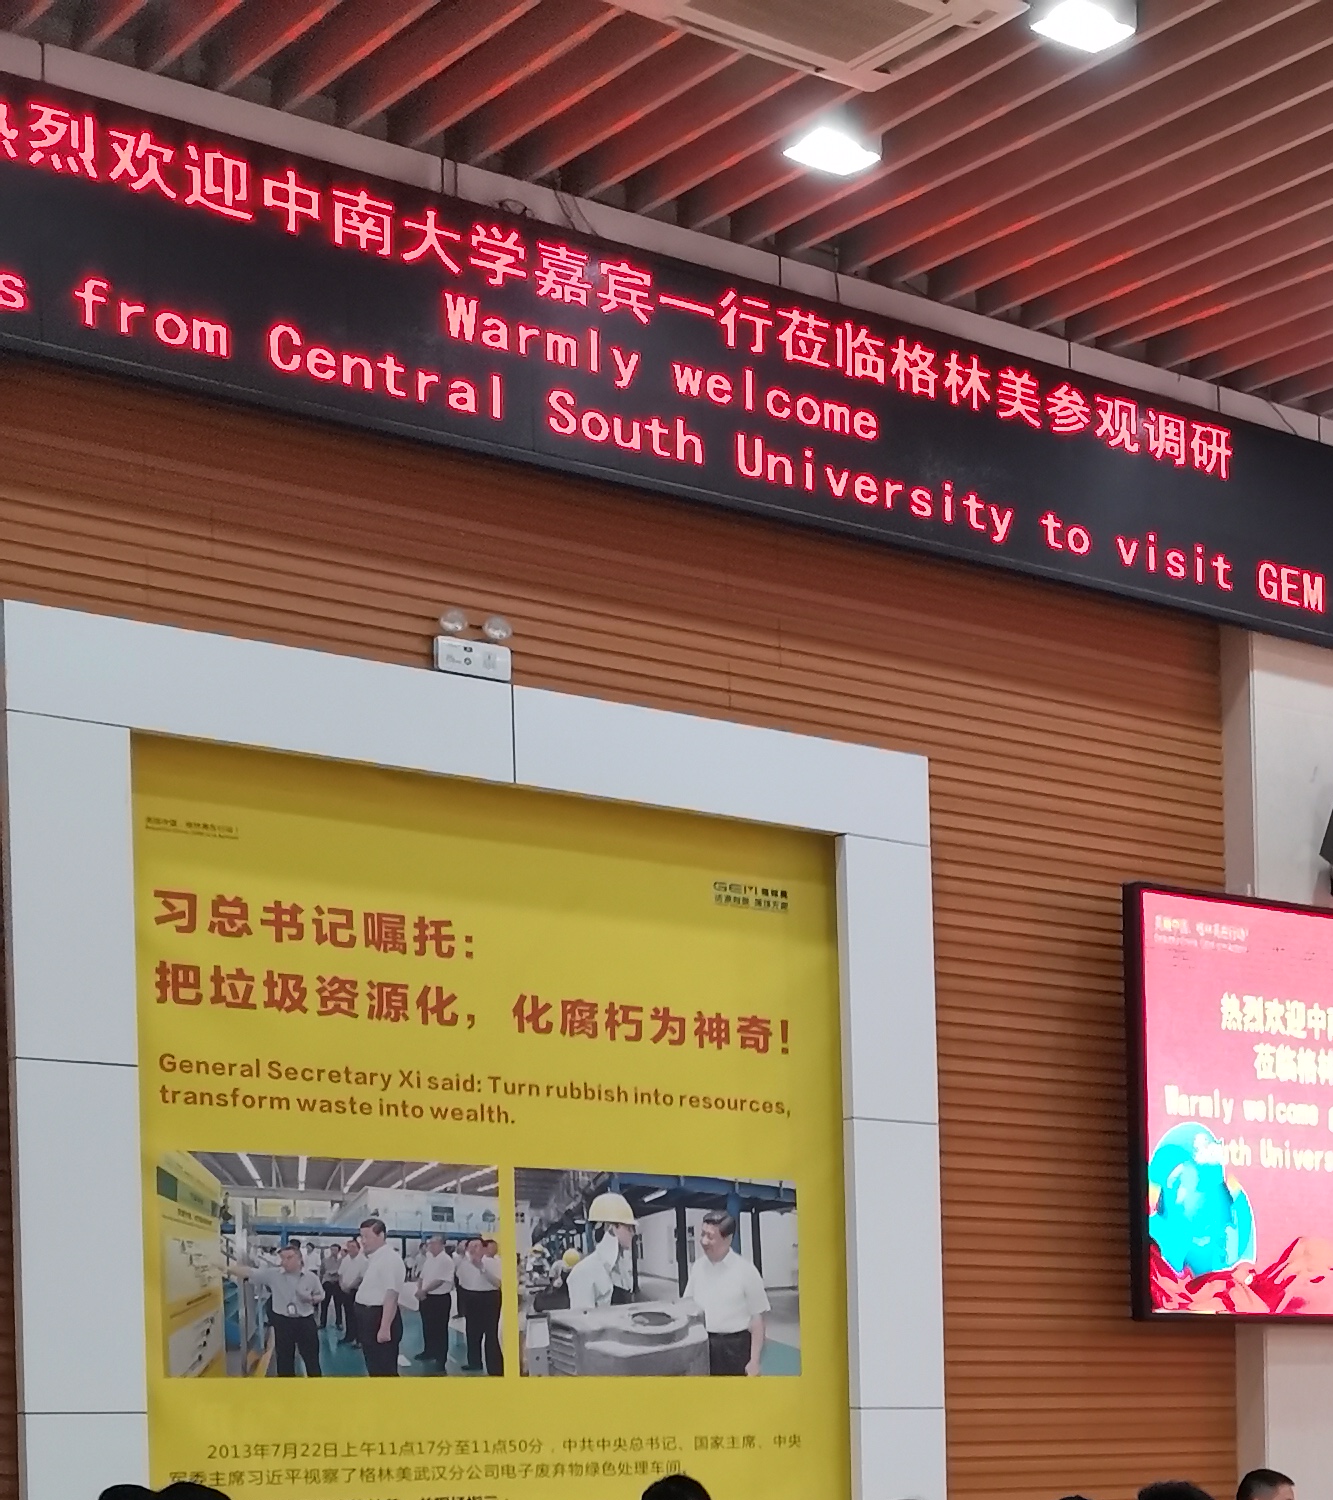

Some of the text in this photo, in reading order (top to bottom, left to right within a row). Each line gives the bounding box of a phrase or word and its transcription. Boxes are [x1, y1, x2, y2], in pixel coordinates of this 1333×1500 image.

[0, 103, 1234, 480] 烈欢迎中南大学嘉宾一行莅临格林美参观调研
[444, 292, 878, 441] Warmly welcome
[74, 278, 228, 358] from
[268, 324, 502, 420] Central
[547, 390, 704, 465] South
[736, 431, 1014, 544] University
[1039, 511, 1091, 556] to
[1116, 531, 1234, 592] visit
[1257, 561, 1324, 614] GEM
[153, 889, 475, 959] 习总书记嘱托：
[158, 1052, 791, 1118] General Secretary Xi said: Turn rubbish into resources,
[159, 1084, 516, 1124] transform waste into wealth.
[1164, 1084, 1235, 1125] Warmly
[1242, 1093, 1319, 1127] welcome
